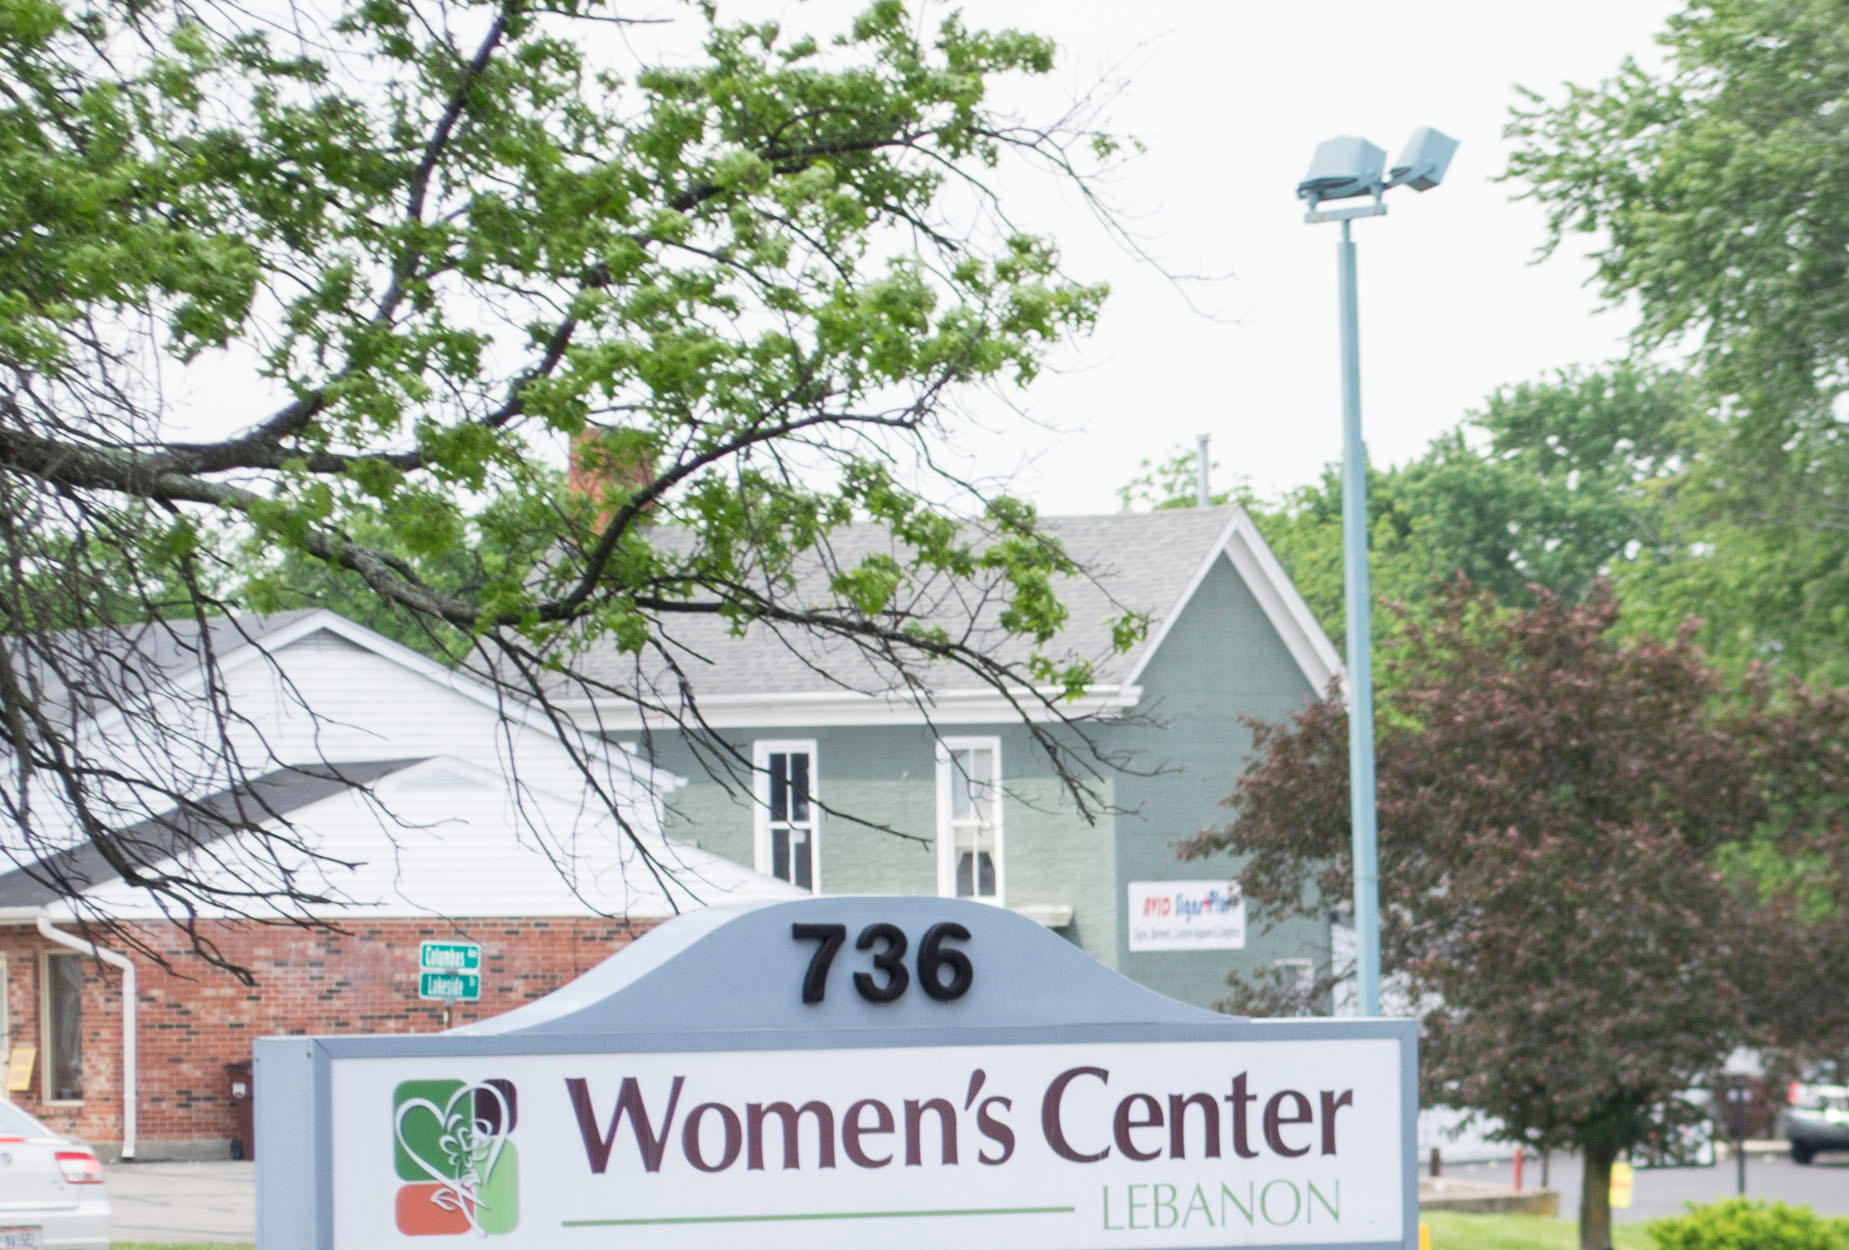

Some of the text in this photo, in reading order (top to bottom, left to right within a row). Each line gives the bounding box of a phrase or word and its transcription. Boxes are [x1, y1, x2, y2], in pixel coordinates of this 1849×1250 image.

[791, 922, 974, 1003] 736
[564, 1066, 1353, 1176] Women's Center
[1102, 1178, 1340, 1231] LEBANON
